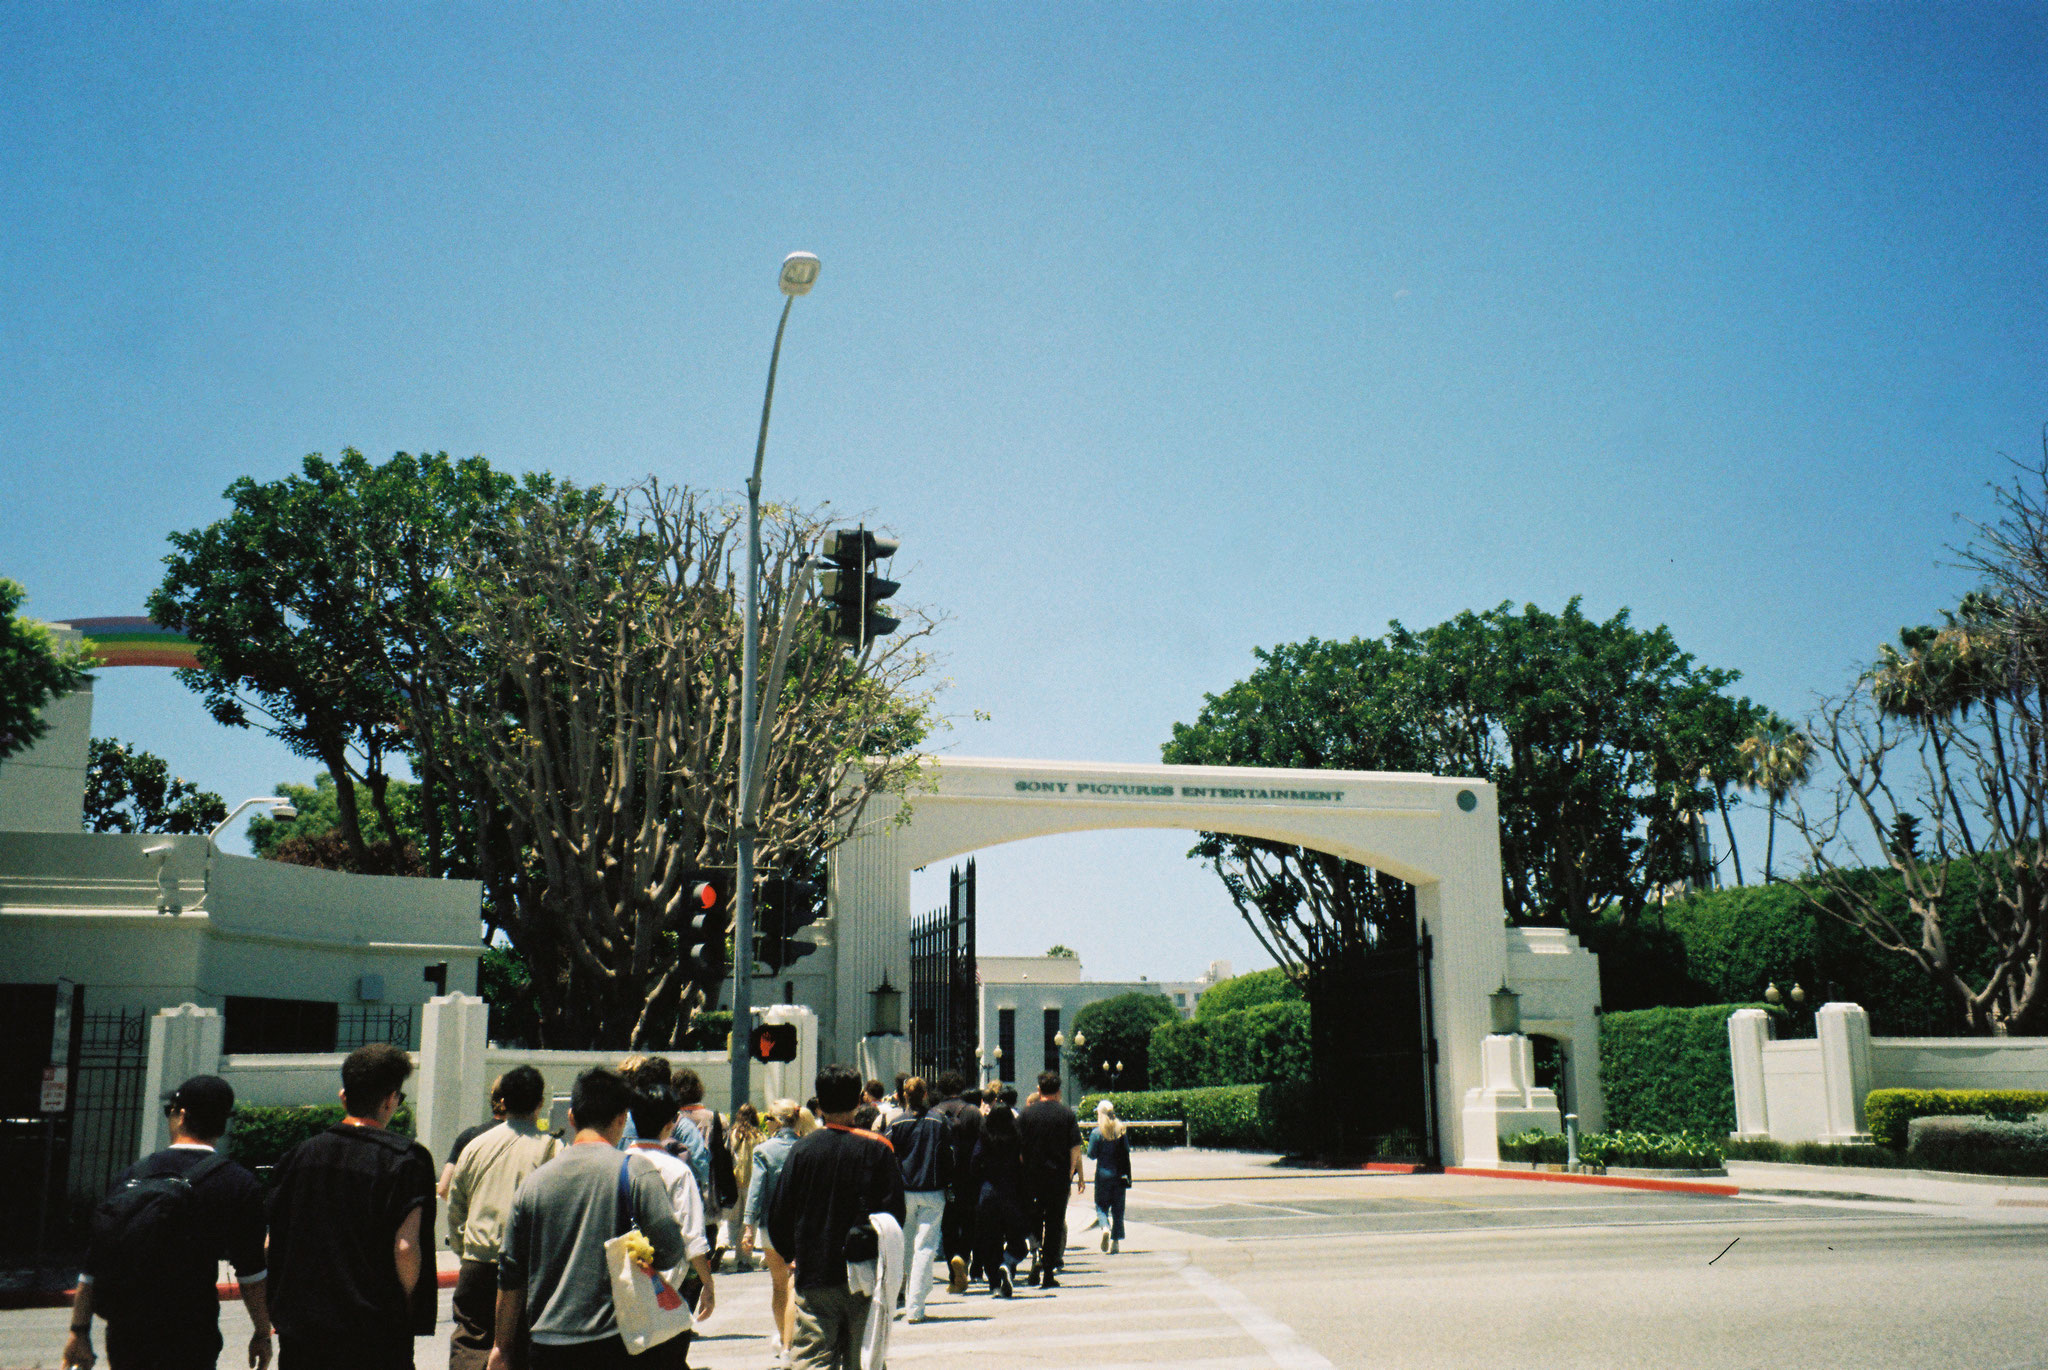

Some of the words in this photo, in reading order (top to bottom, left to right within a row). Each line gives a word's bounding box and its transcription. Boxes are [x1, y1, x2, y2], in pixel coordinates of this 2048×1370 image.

[1014, 781, 1068, 793] SONY
[1076, 783, 1174, 796] PICTURES
[1181, 786, 1345, 801] ENTERTAINMENT
